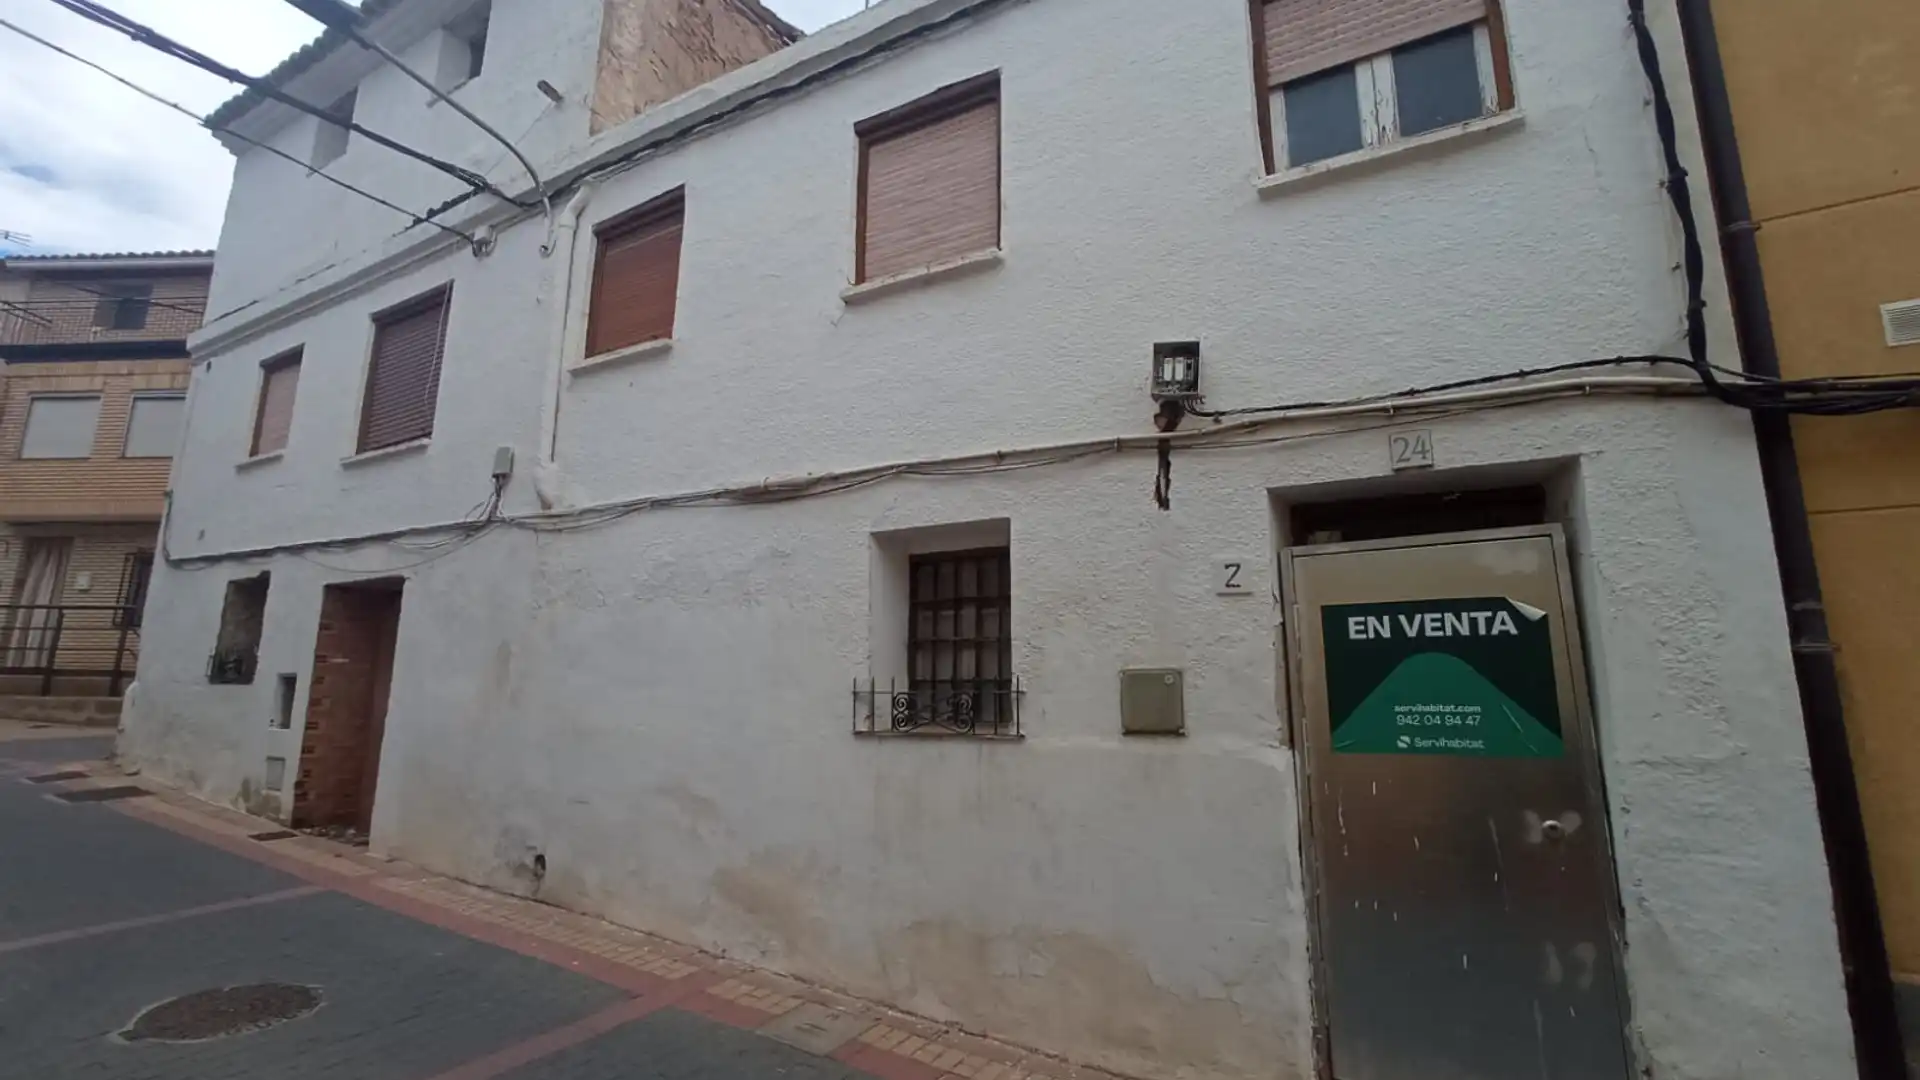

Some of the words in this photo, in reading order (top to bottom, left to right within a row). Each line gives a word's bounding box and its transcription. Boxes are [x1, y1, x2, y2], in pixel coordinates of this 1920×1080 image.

[1393, 435, 1430, 463] 24
[1348, 615, 1391, 640] EN
[1398, 610, 1518, 638] VENTA
[1393, 704, 1481, 713] servihabitat.com
[1396, 714, 1420, 725] 942
[1424, 714, 1441, 725] 04
[1445, 714, 1462, 726] 94
[1465, 715, 1481, 726] 47
[1414, 736, 1485, 749] Servihabitat
